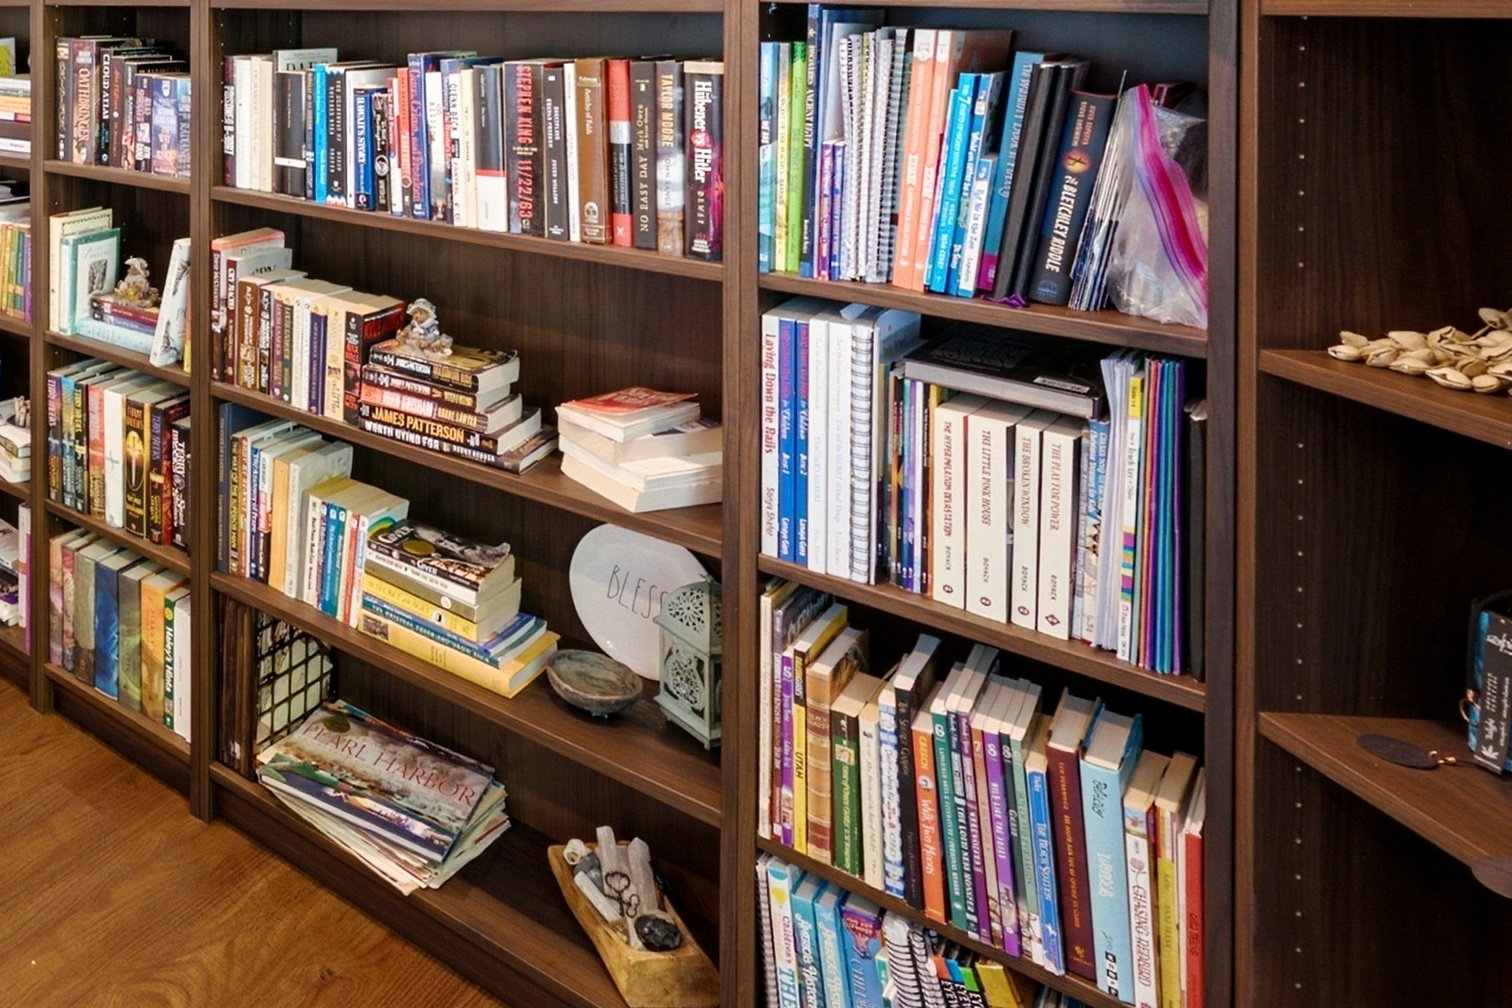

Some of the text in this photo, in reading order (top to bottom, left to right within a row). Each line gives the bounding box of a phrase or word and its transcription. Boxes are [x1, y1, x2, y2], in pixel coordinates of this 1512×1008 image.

[102, 54, 111, 120] CLOUD ATLAS
[77, 67, 91, 142] OATHBRINGER
[660, 74, 674, 148] TAYLOR MOORE
[357, 136, 368, 164] STORY
[516, 64, 534, 219] STEPHEN KING 11/22/63
[637, 155, 648, 179] DAY
[693, 148, 712, 183] Hitler
[638, 182, 649, 211] EASY
[639, 214, 649, 232] NO
[1044, 184, 1077, 273] BLETCHLEY RIDDLE
[763, 333, 777, 454] Laying Down the Rails
[364, 420, 394, 438] WORTH
[422, 434, 440, 451] FOR
[371, 406, 465, 443] JAMES PATTERSON
[981, 429, 992, 445] THE
[981, 447, 992, 475] LITTLE
[1021, 437, 1032, 452] THE
[1020, 453, 1032, 489] BROKEN
[981, 498, 991, 527] HOUSE
[1020, 489, 1031, 527] WINDOW
[165, 664, 174, 692] Hints
[301, 721, 479, 807] PEARL HARBOR
[794, 751, 805, 779] UTAH
